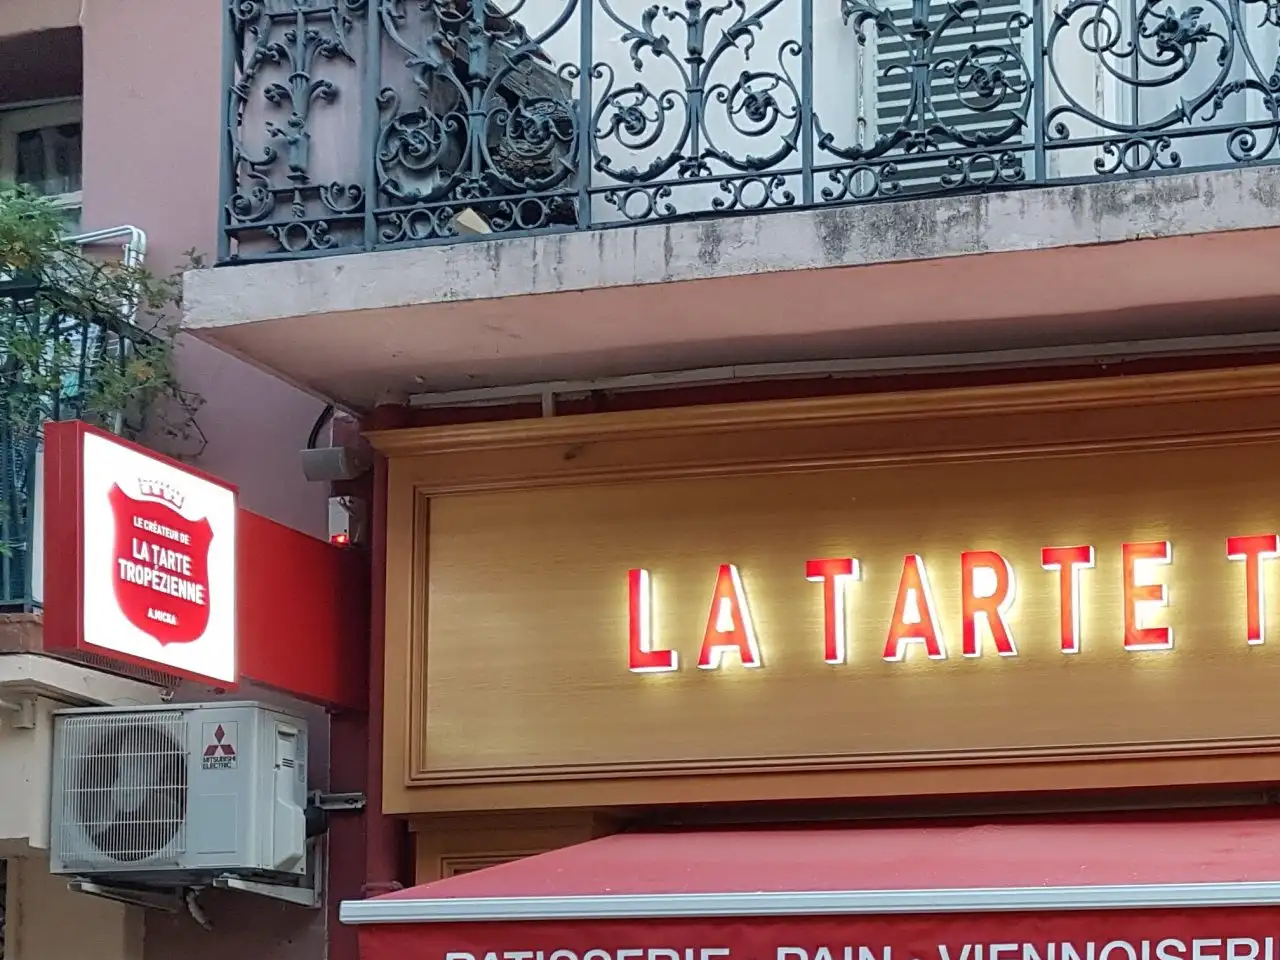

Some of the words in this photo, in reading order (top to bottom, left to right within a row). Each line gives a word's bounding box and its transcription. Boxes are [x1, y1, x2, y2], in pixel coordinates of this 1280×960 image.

[133, 515, 144, 529] LE
[144, 520, 179, 541] CRÉATEUR
[179, 533, 191, 546] DE
[132, 537, 149, 562] LA
[151, 543, 192, 577] TARTE
[118, 557, 206, 606] TROPÉZIENNE
[629, 563, 760, 672] LA
[806, 540, 1173, 663] TARTE
[203, 755, 236, 763] MITSUBISHI
[203, 762, 232, 770] ELECTRIC
